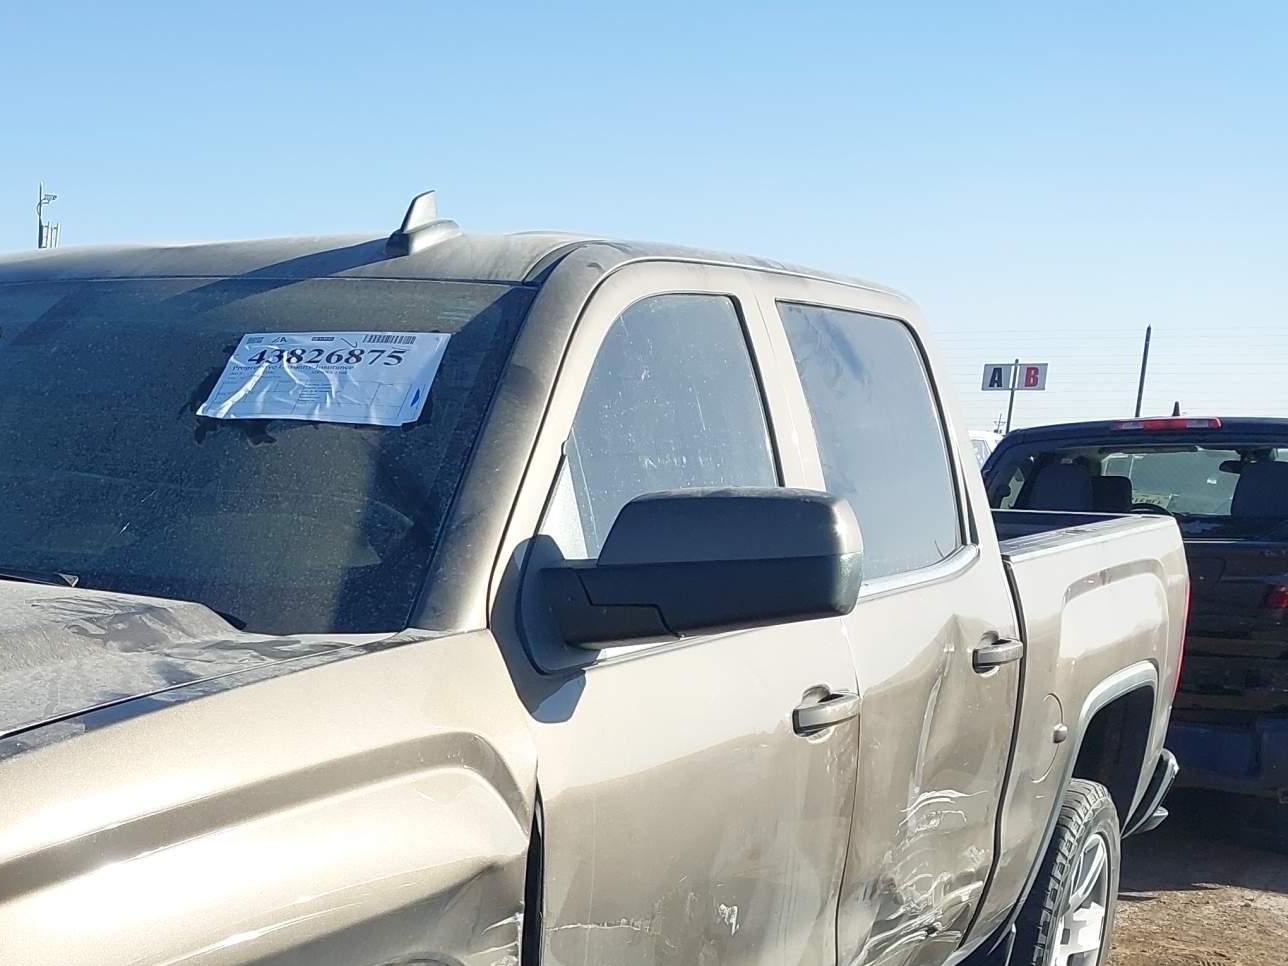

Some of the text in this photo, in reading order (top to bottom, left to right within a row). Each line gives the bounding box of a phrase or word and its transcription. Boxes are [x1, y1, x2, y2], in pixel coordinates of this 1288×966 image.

[247, 348, 407, 365] 43826875
[988, 367, 1039, 388] A B
